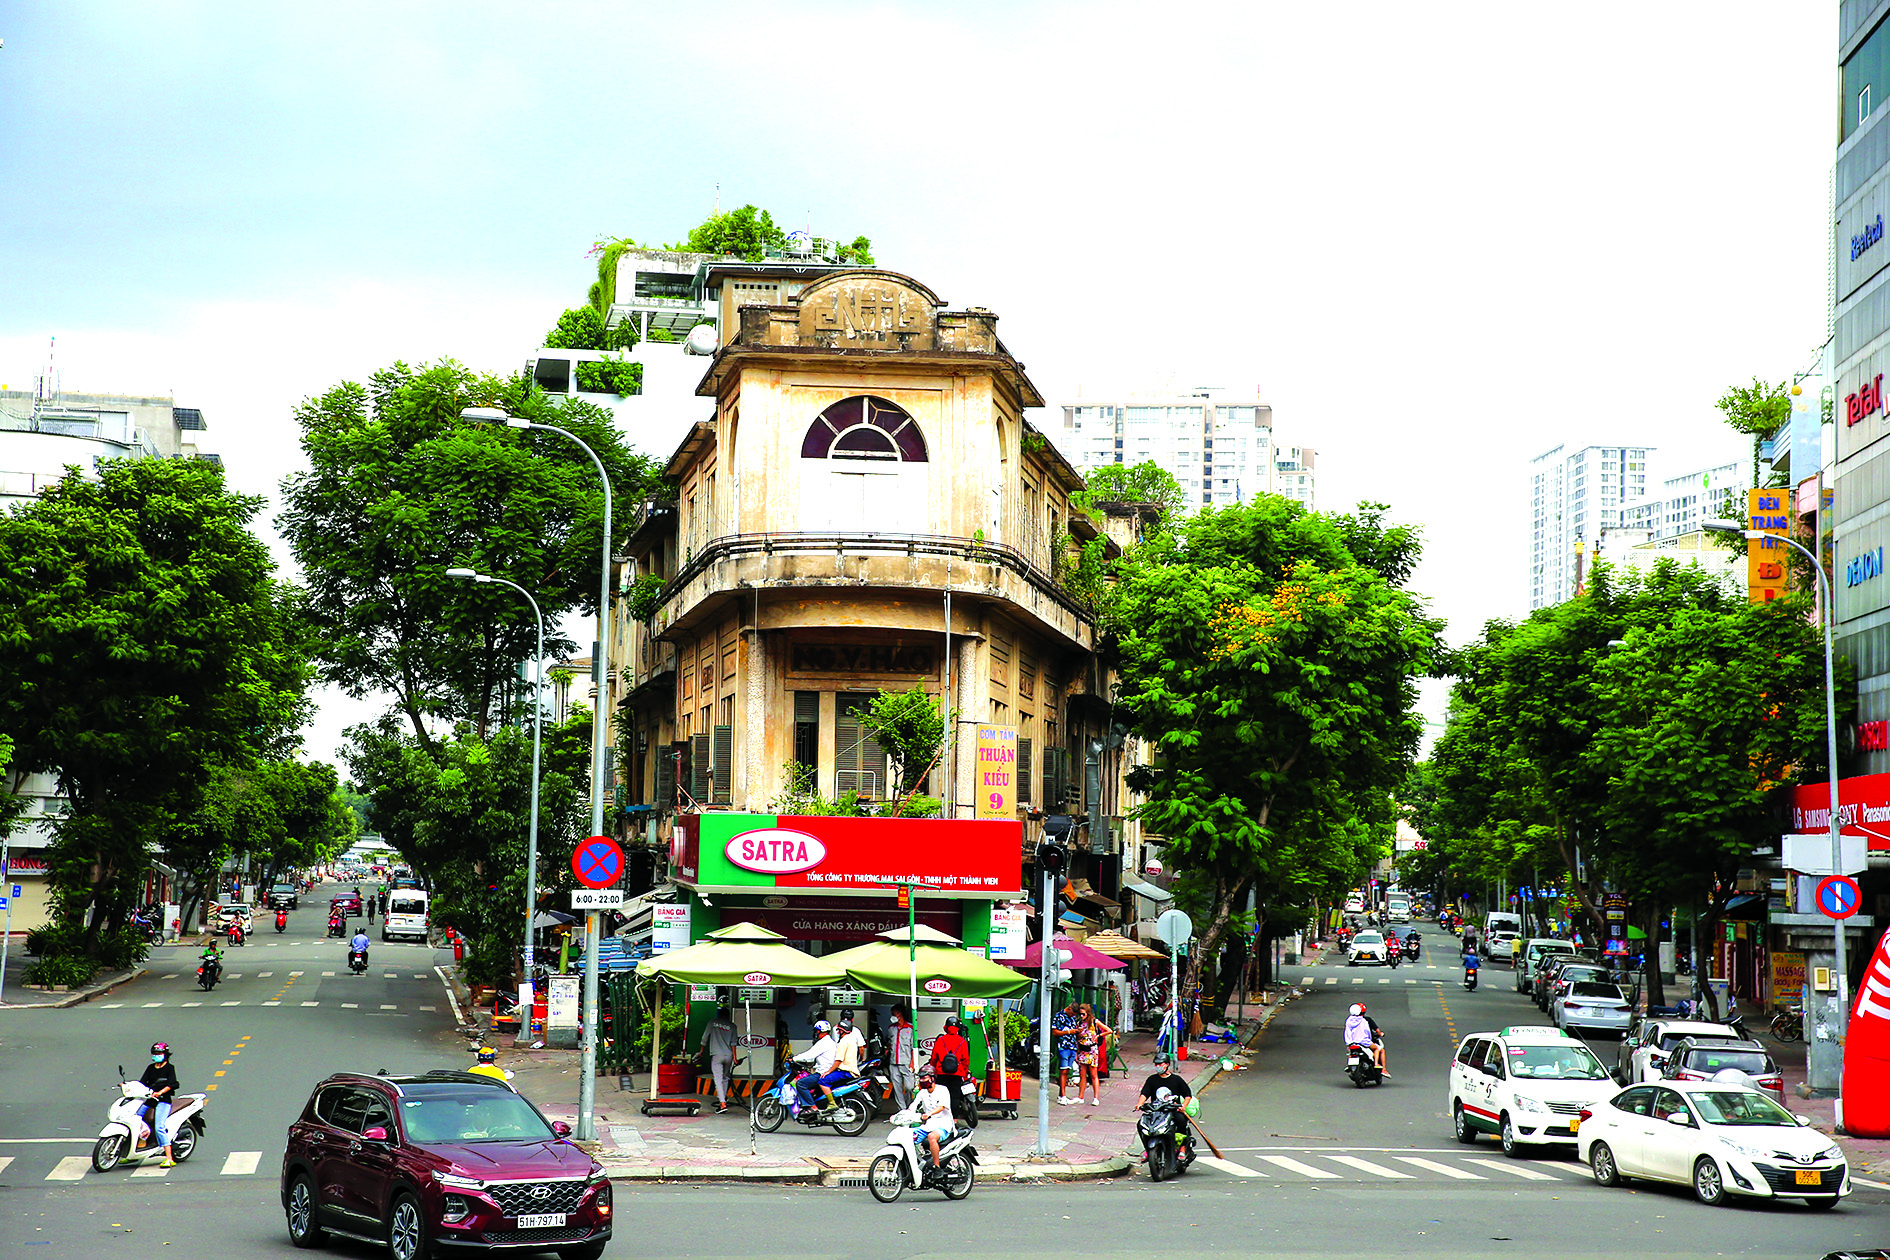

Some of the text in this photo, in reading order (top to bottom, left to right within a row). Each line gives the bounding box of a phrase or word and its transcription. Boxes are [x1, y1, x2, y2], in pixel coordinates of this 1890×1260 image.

[1844, 374, 1883, 428] Tefal
[1751, 515, 1788, 529] TRANG
[999, 727, 1014, 741] TẤM
[978, 745, 1015, 766] THUẬN
[989, 792, 1004, 810] 9
[1793, 807, 1803, 830] LG
[1838, 803, 1858, 825] ONY
[741, 839, 809, 862] SATRA
[1414, 841, 1426, 851] 59
[844, 873, 853, 882] TY
[924, 875, 941, 884] TNHH
[576, 894, 593, 904] 6:00
[598, 895, 620, 904] 22:00
[657, 906, 675, 916] BẢNG
[792, 918, 812, 930] CỬA
[814, 919, 844, 931] HÀNG
[845, 920, 876, 931] XĂNG
[1776, 966, 1806, 977] MASSAGE
[747, 974, 767, 983] SATRA
[927, 982, 947, 990] SATRA
